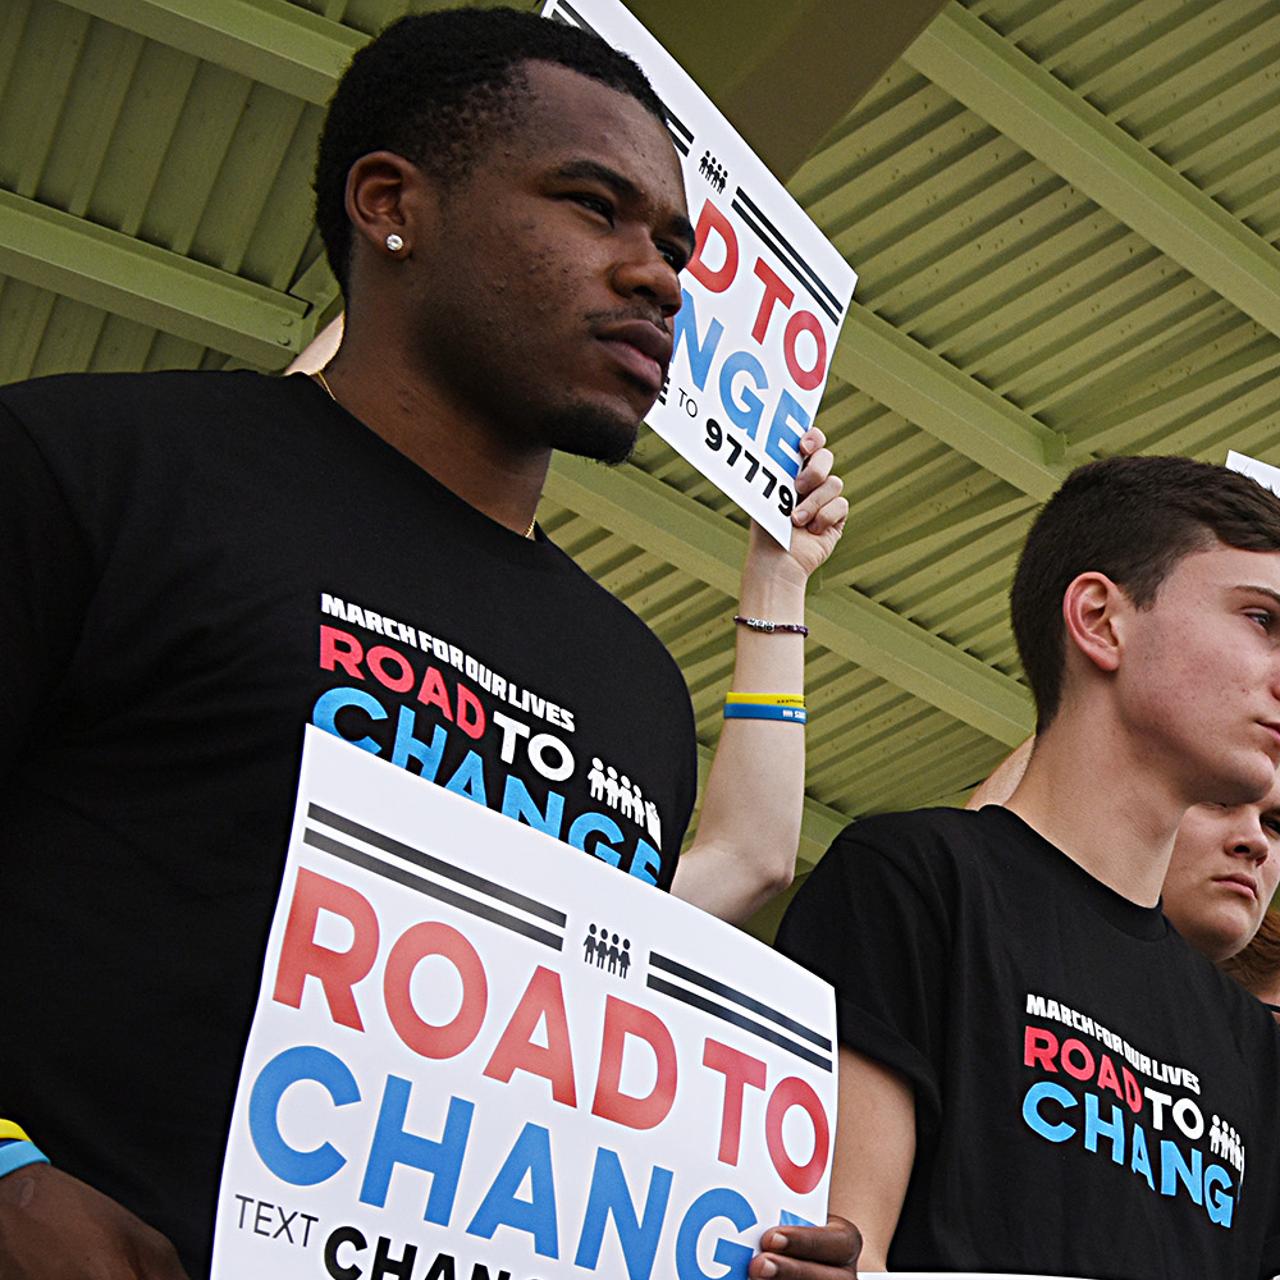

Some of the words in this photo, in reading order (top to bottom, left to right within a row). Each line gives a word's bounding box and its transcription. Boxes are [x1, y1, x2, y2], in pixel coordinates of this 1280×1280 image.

[668, 289, 811, 480] NGE
[754, 257, 827, 391] TO
[678, 387, 698, 418] TO
[705, 418, 794, 517] 97779
[319, 625, 486, 740] ROAD
[494, 711, 575, 782] TO
[321, 593, 417, 648] MARCH
[419, 632, 464, 673] FOR
[465, 657, 506, 700] OUR
[507, 682, 576, 733] LIVES
[272, 867, 678, 1130] ROAD
[703, 1037, 830, 1195] TO
[1023, 1025, 1143, 1114] ROAD
[1144, 1086, 1205, 1141] TO
[1026, 993, 1095, 1038] MARCH
[1095, 1021, 1124, 1056] FOR
[1124, 1040, 1152, 1076] OUR
[1151, 1058, 1201, 1095] LIVES
[235, 1195, 319, 1249] TEXT
[1022, 1081, 1235, 1229] CHANG
